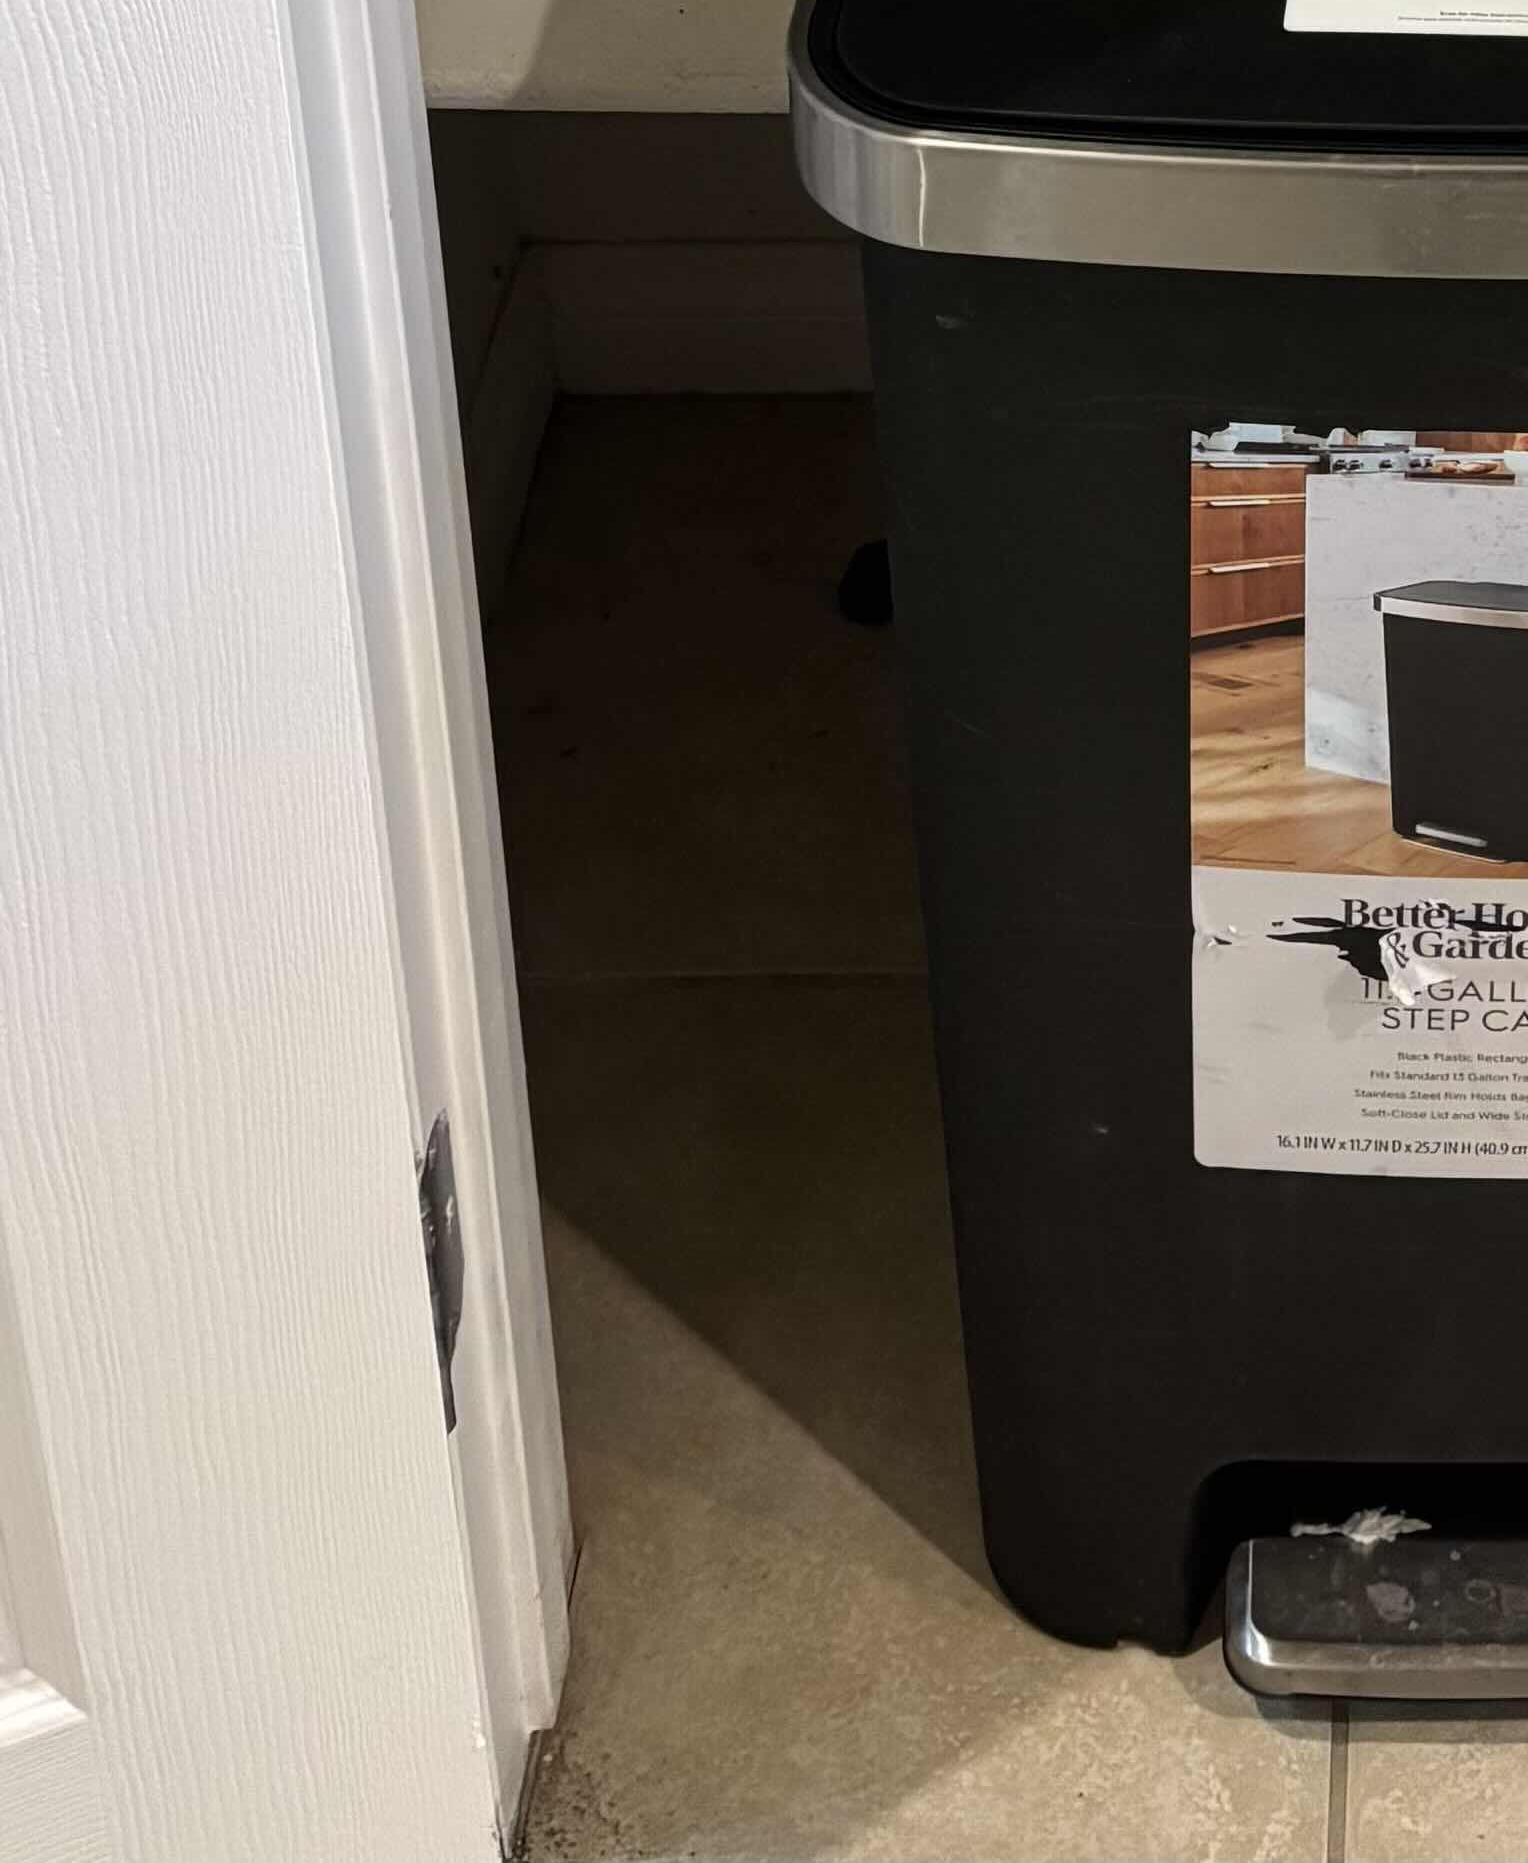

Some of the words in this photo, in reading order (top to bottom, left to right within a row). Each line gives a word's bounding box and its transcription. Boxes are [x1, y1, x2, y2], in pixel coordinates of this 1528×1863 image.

[1341, 898, 1465, 931] Better
[1386, 931, 1411, 970] &
[1381, 1007, 1470, 1031] STEP
[1398, 1052, 1431, 1062] Black
[1433, 1052, 1474, 1063] Plastic
[1354, 1088, 1407, 1101] Stainless
[1409, 1090, 1441, 1101] Steel
[1444, 1092, 1467, 1101] Rim
[1470, 1092, 1507, 1102] Holds
[1361, 1108, 1427, 1120] Soft-Close
[1430, 1109, 1449, 1120] Lid
[1451, 1110, 1476, 1120] and
[1478, 1111, 1511, 1121] Wide
[1276, 1135, 1302, 1149] 16.1
[1303, 1135, 1318, 1149] IN
[1320, 1137, 1336, 1150] W
[1337, 1140, 1347, 1151] x
[1349, 1138, 1373, 1152] 11.7
[1374, 1139, 1389, 1152] IN
[1391, 1140, 1402, 1152] D
[1403, 1143, 1413, 1153] x
[1414, 1140, 1440, 1154] 25.7
[1443, 1141, 1459, 1154] IN
[1460, 1142, 1472, 1154] H
[1474, 1142, 1509, 1156] (40.9
